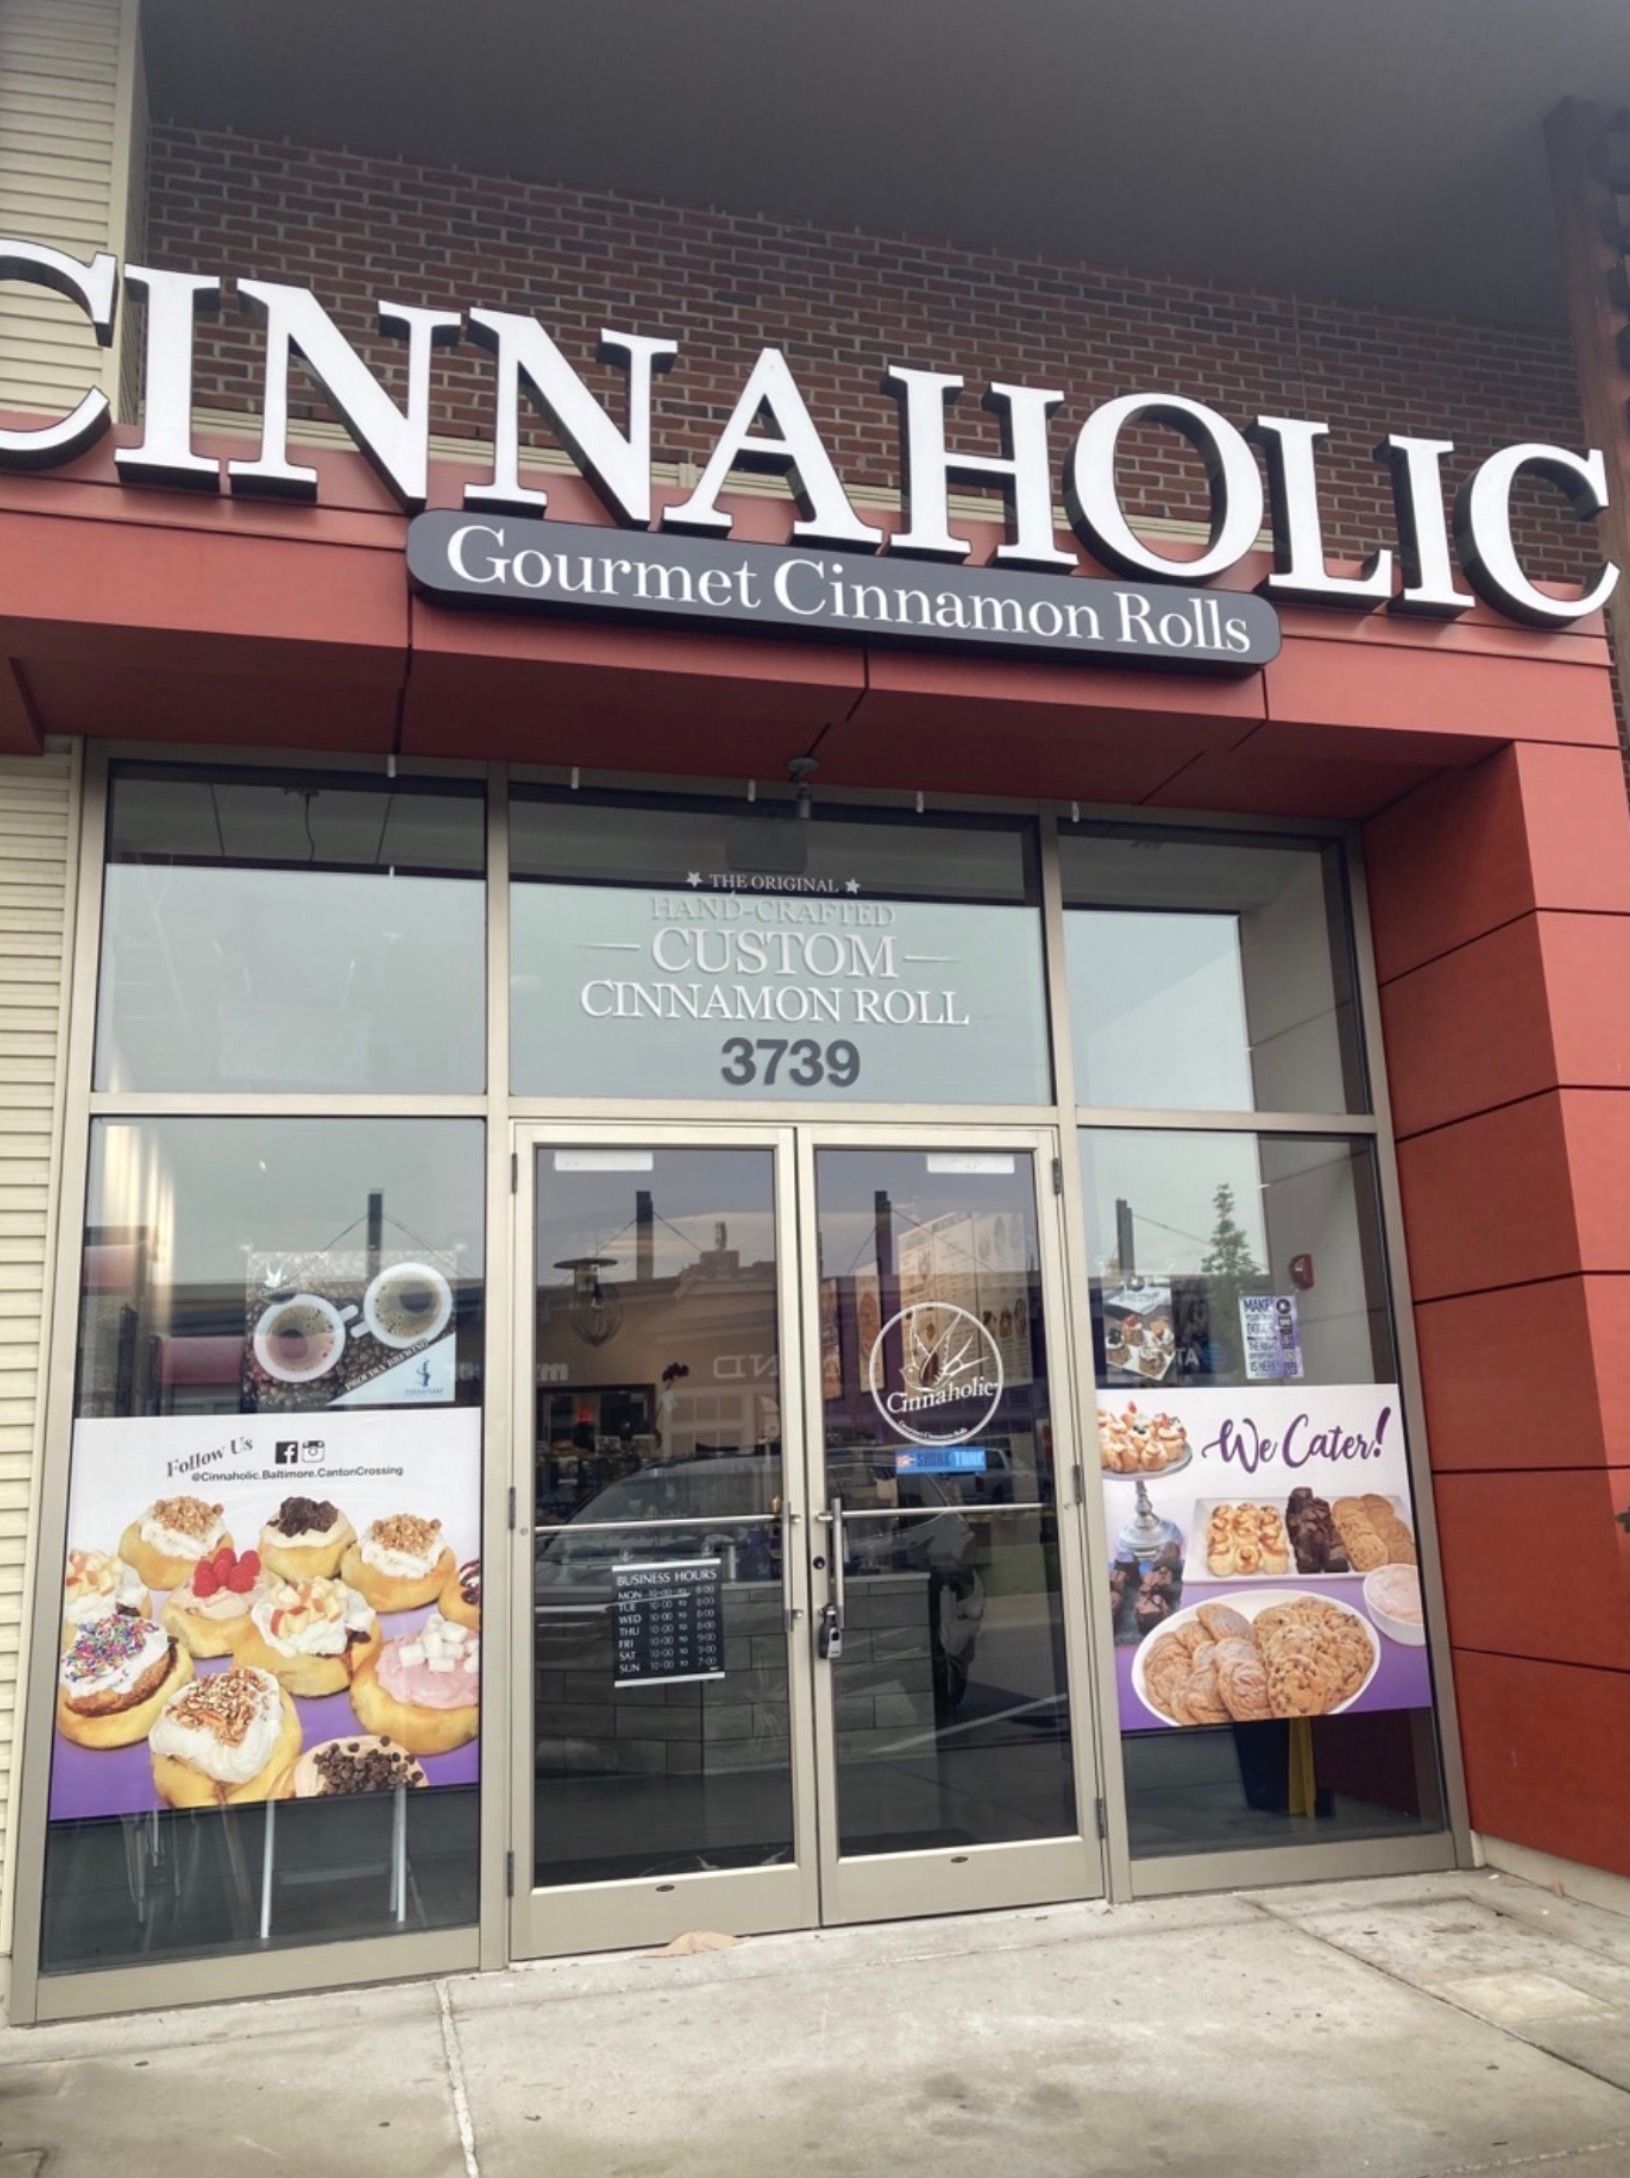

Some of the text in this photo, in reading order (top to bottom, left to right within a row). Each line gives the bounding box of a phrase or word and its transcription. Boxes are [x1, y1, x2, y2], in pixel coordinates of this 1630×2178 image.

[0, 237, 1620, 619] CINNAHOLIC
[446, 525, 1252, 654] Gourmet Cinnamon Rolls
[709, 872, 839, 894] THE ORIGINAL
[650, 896, 897, 927] HAND-CRAFTED
[651, 926, 900, 979] CUSTOM
[580, 979, 971, 1025] CINNAMON ROLL
[721, 1036, 861, 1087] 3739
[886, 1376, 995, 1414] Cinnaholic
[1201, 1406, 1392, 1474] We Cater!
[166, 1437, 254, 1477] Follow Us
[191, 1466, 404, 1483] @Cinnaholic.Baltimore.CantonCrossing
[616, 1568, 717, 1586] BUSINESS HOURS
[618, 1591, 643, 1600] MON
[618, 1614, 642, 1624] WED
[619, 1626, 640, 1636] THU
[618, 1639, 634, 1649] FRI
[619, 1650, 636, 1661] SAT
[619, 1662, 641, 1674] SUN
